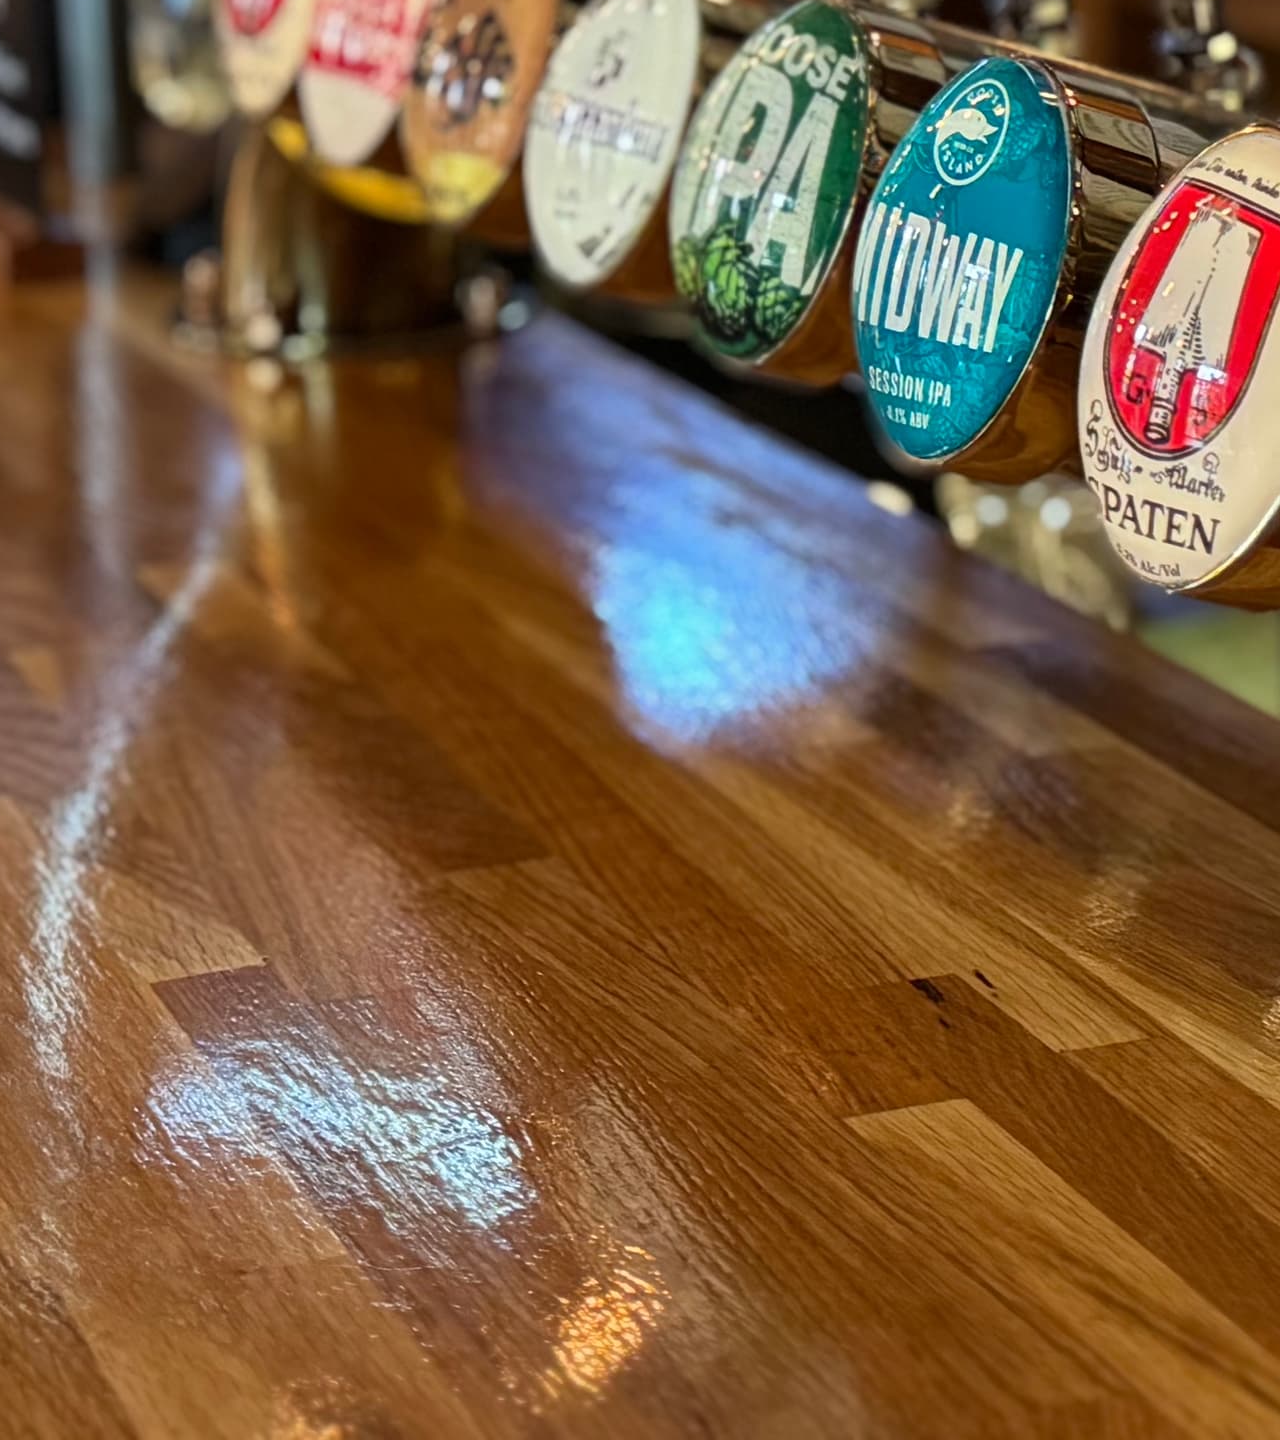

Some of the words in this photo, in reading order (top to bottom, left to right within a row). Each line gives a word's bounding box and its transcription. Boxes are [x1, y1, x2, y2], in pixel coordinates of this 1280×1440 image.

[941, 143, 985, 174] ISLAND
[853, 202, 1024, 353] MIDWAY
[869, 365, 925, 403] SESSION
[928, 379, 951, 408] IPA
